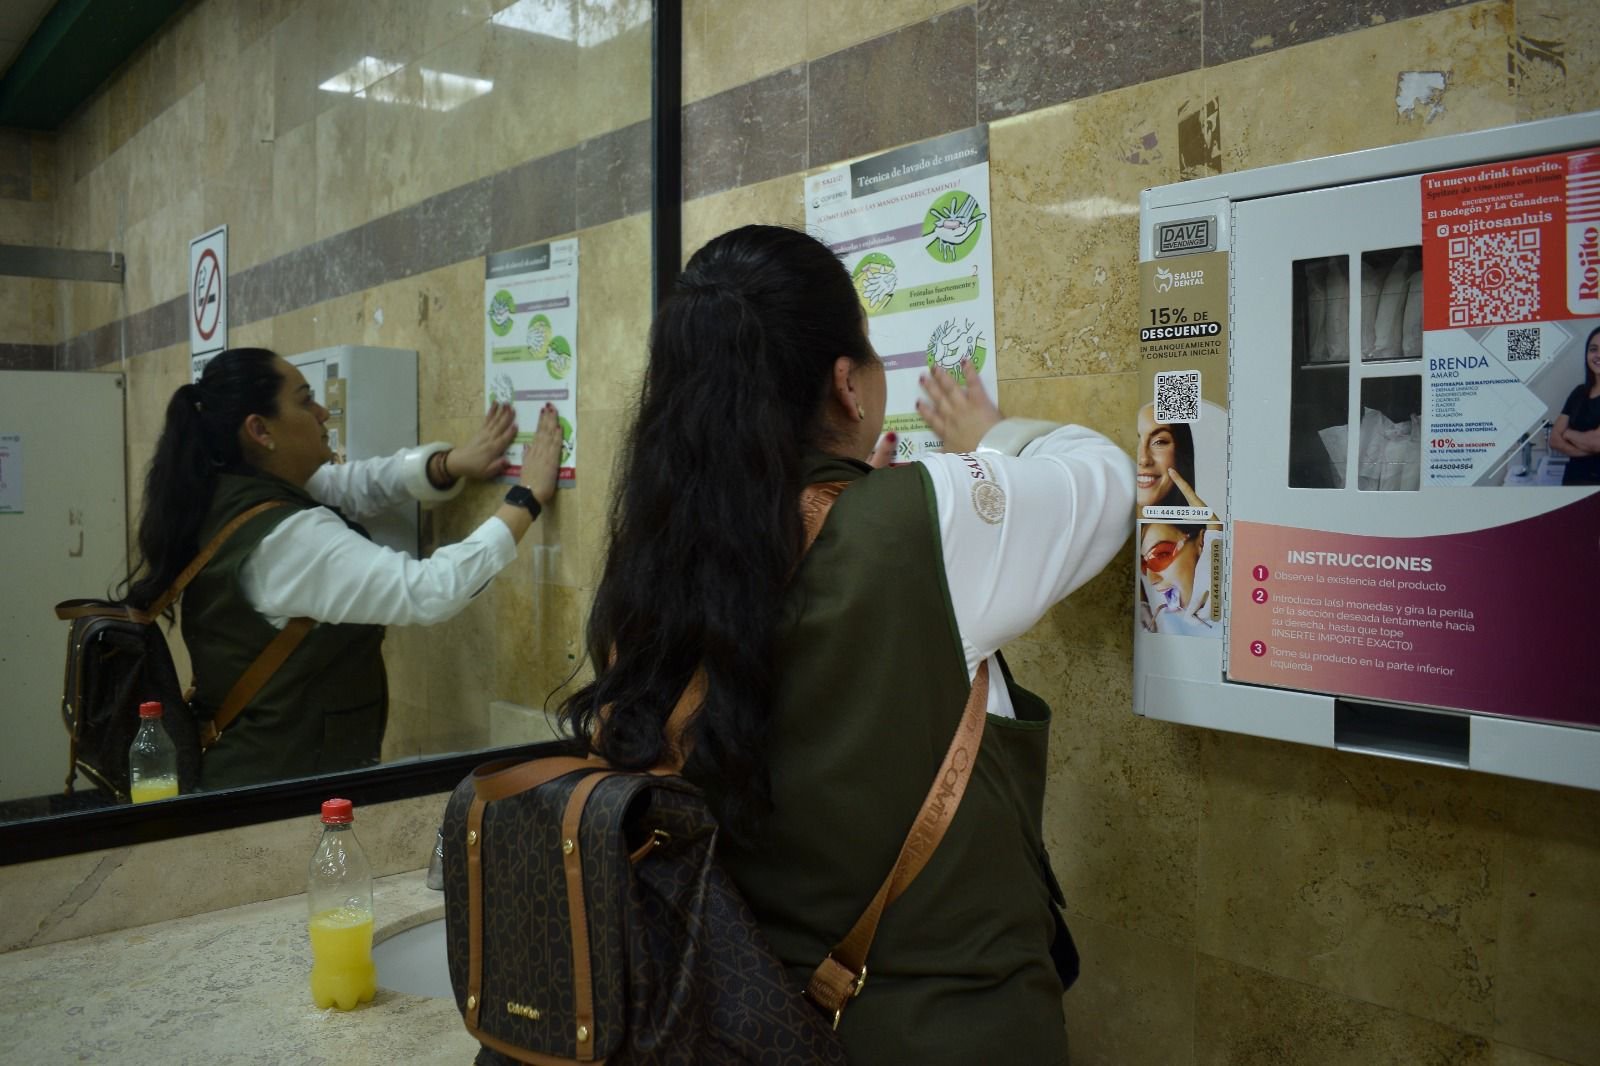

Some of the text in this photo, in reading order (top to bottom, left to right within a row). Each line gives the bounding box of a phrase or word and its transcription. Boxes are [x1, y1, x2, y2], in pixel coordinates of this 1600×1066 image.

[857, 147, 978, 188] Técnica de lavado de manos.
[1427, 161, 1562, 188] Tu nuevo drink favorito.
[1427, 194, 1563, 220] El Bodegón y La Ganadera.
[1453, 210, 1553, 235] rojitosanluis
[1164, 223, 1206, 243] DAVE
[1169, 239, 1200, 249] VENDING
[1578, 226, 1600, 301] Rojito
[1174, 270, 1204, 281] SALUD
[1174, 278, 1205, 288] DENTAL
[1150, 307, 1208, 325] 15% DE
[1142, 323, 1218, 340] DESCUENTO
[1146, 350, 1188, 360] CONSULTA
[1190, 347, 1221, 357] INICIAL
[1149, 340, 1221, 352] BLANQUEAMIENTO
[1429, 355, 1490, 371] BRENDA
[1430, 371, 1460, 379] AMARO
[1430, 438, 1456, 448] 10%
[1287, 550, 1433, 572] INSTRUCCIONES
[1258, 568, 1447, 592] 1 Observe la existencia del producto
[1256, 590, 1475, 619] 2 Introduzca la(s) monedas y gira la perilla
[1272, 605, 1476, 632] de la sección deseada lentamente hacia
[1272, 619, 1404, 639] su derecha, hasta que tope
[1271, 628, 1413, 652] (INSERTE IMPORTE EXACTO)
[1254, 643, 1455, 676] 3 Tome su producto en la parte inferior
